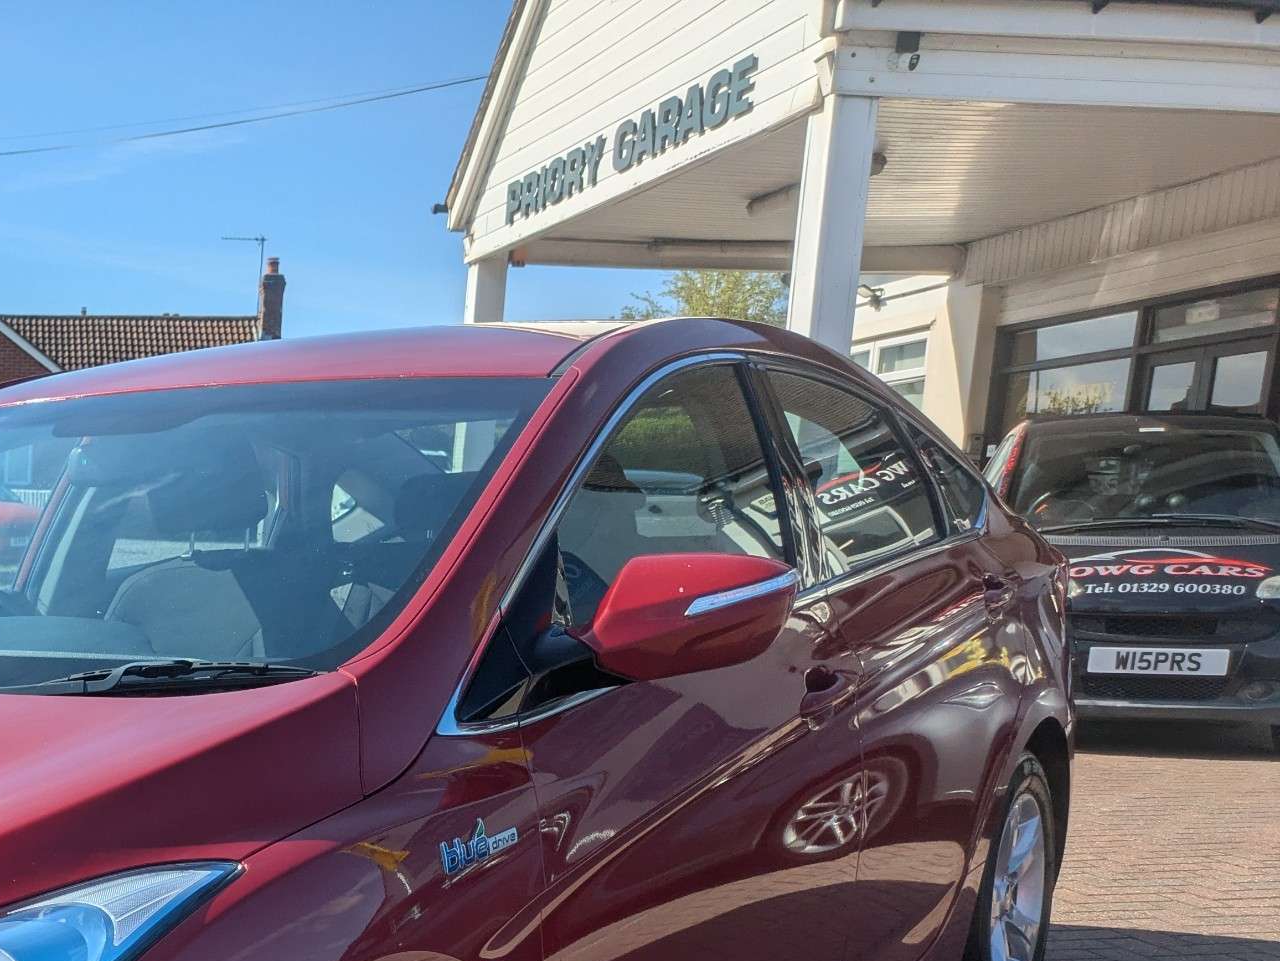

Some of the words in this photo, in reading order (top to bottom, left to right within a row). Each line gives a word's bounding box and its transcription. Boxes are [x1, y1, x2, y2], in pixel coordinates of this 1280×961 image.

[505, 135, 606, 226] PRIORY
[612, 53, 759, 173] GARAGE
[1069, 563, 1156, 578] OWG
[1164, 563, 1266, 579] CARS
[1084, 583, 1115, 594] Tel:
[1117, 582, 1170, 594] 01329
[1173, 583, 1246, 596] 600380
[1114, 651, 1202, 673] W15PRS
[440, 835, 490, 874] blue
[491, 832, 517, 851] drive
